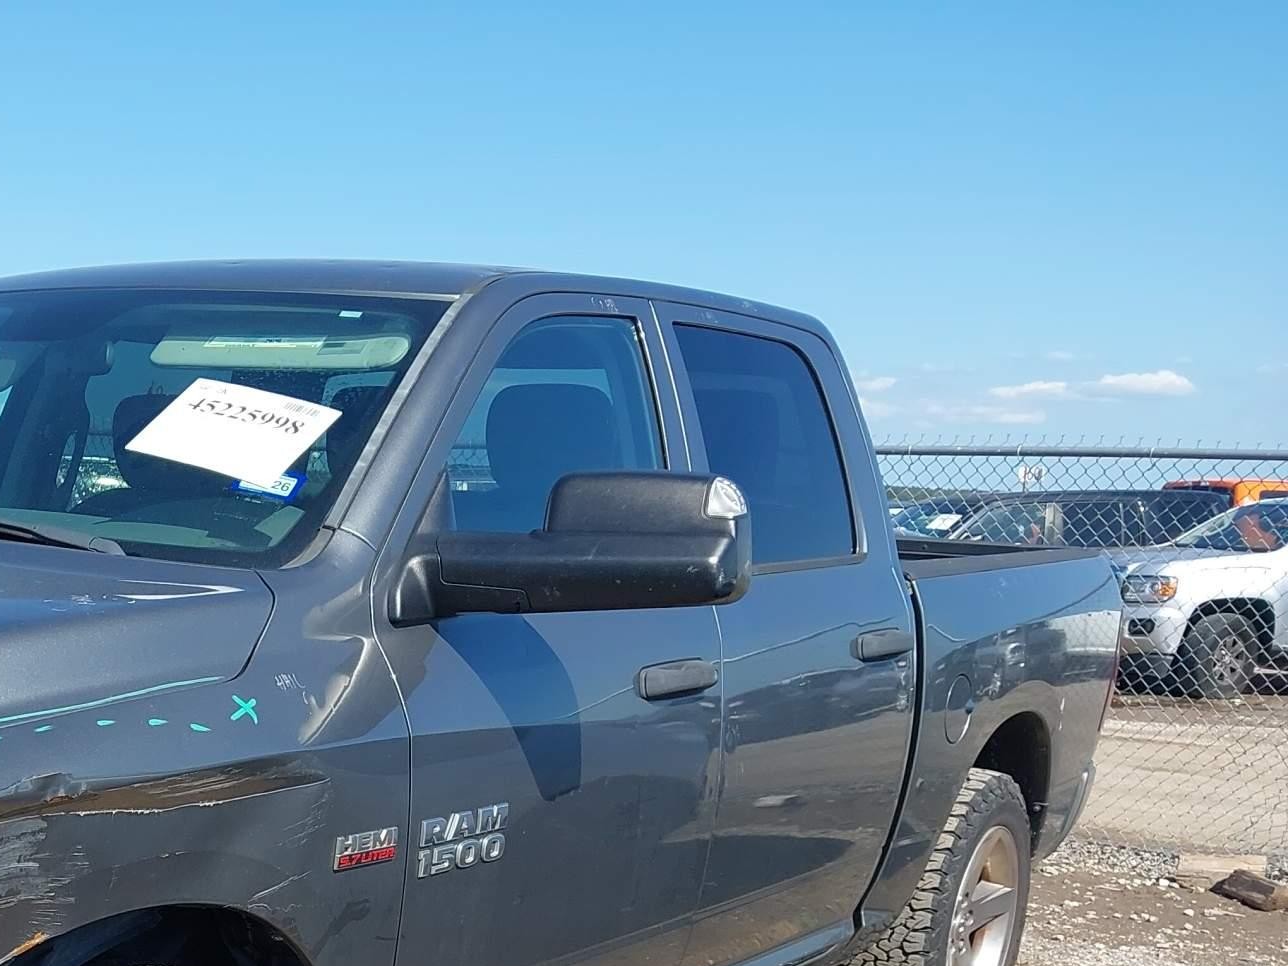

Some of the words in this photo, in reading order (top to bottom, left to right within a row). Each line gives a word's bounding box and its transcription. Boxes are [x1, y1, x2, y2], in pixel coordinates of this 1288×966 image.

[188, 397, 305, 434] 45225998
[271, 480, 291, 491] 26
[336, 827, 399, 856] HEMI
[419, 803, 509, 848] RAM
[417, 832, 506, 879] 1500
